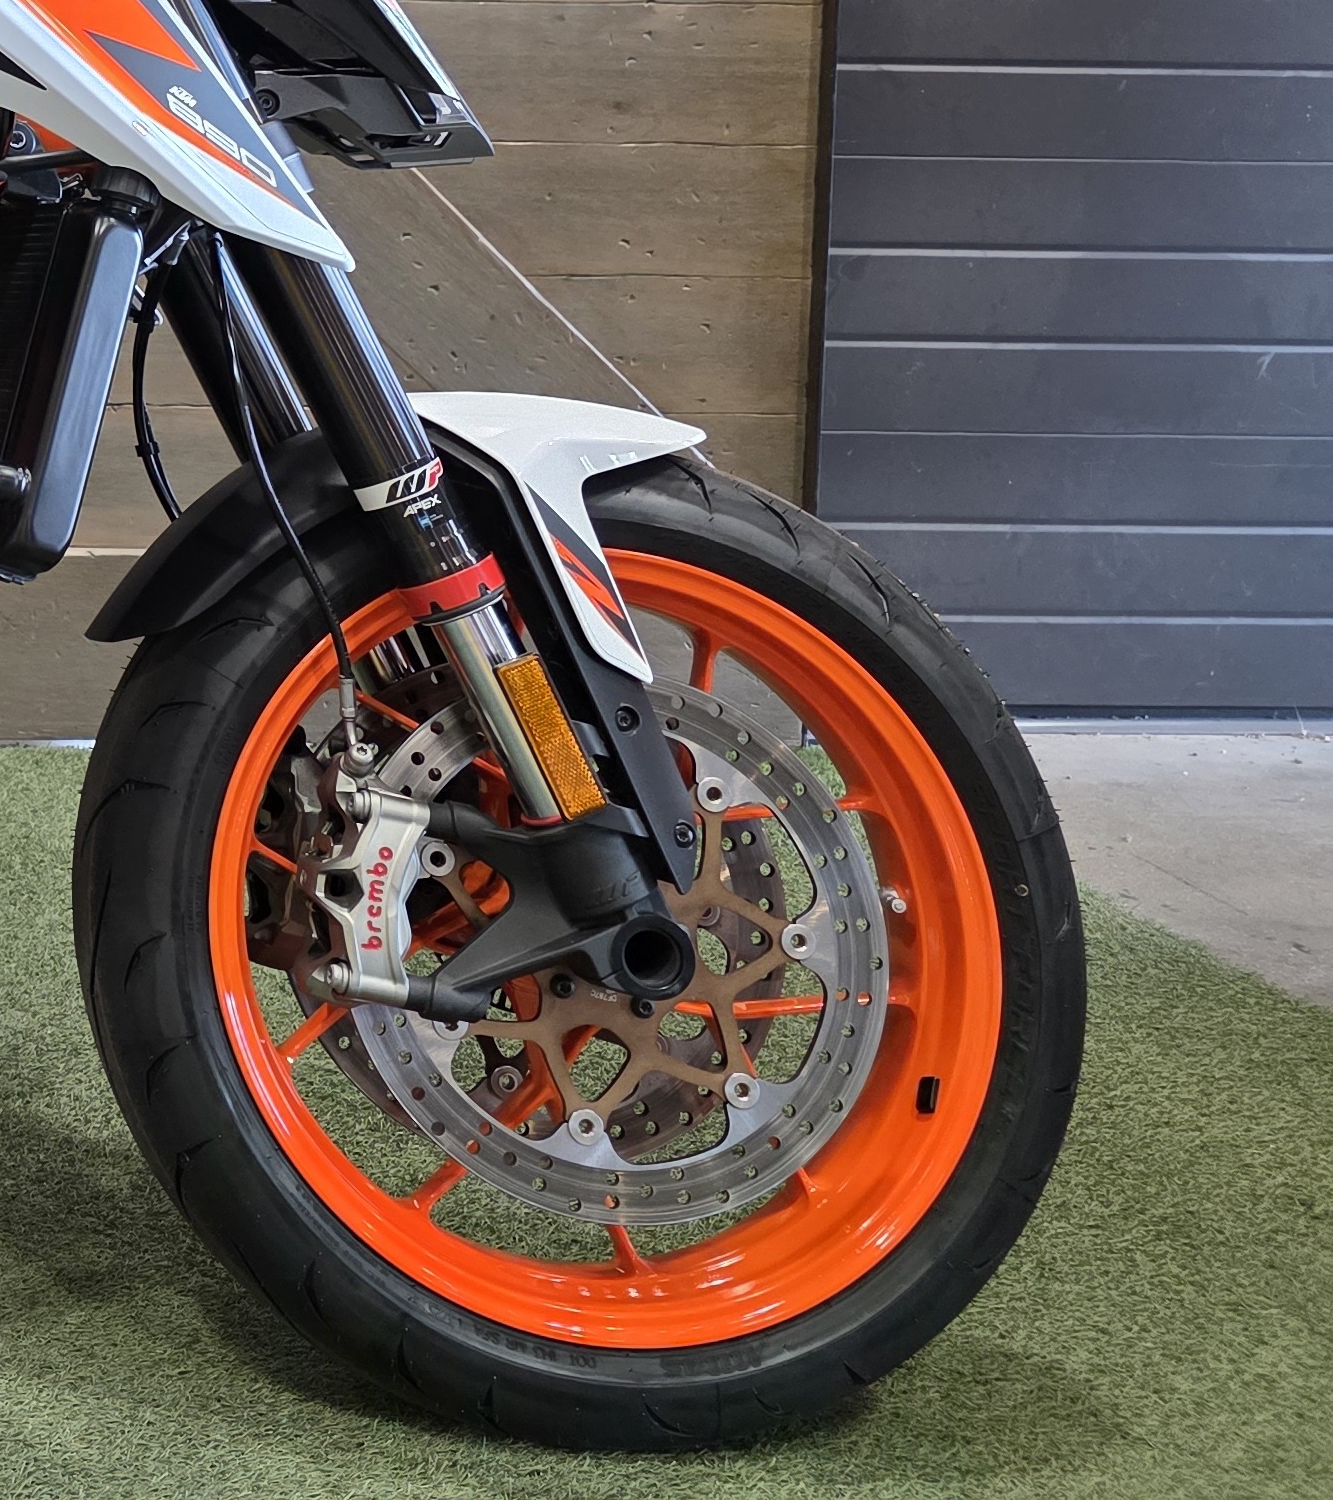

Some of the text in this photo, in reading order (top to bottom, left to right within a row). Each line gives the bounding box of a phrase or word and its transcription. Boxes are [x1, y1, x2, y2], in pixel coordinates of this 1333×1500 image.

[166, 92, 277, 188] 890
[402, 493, 442, 518] APEX
[360, 846, 394, 951] brembo
